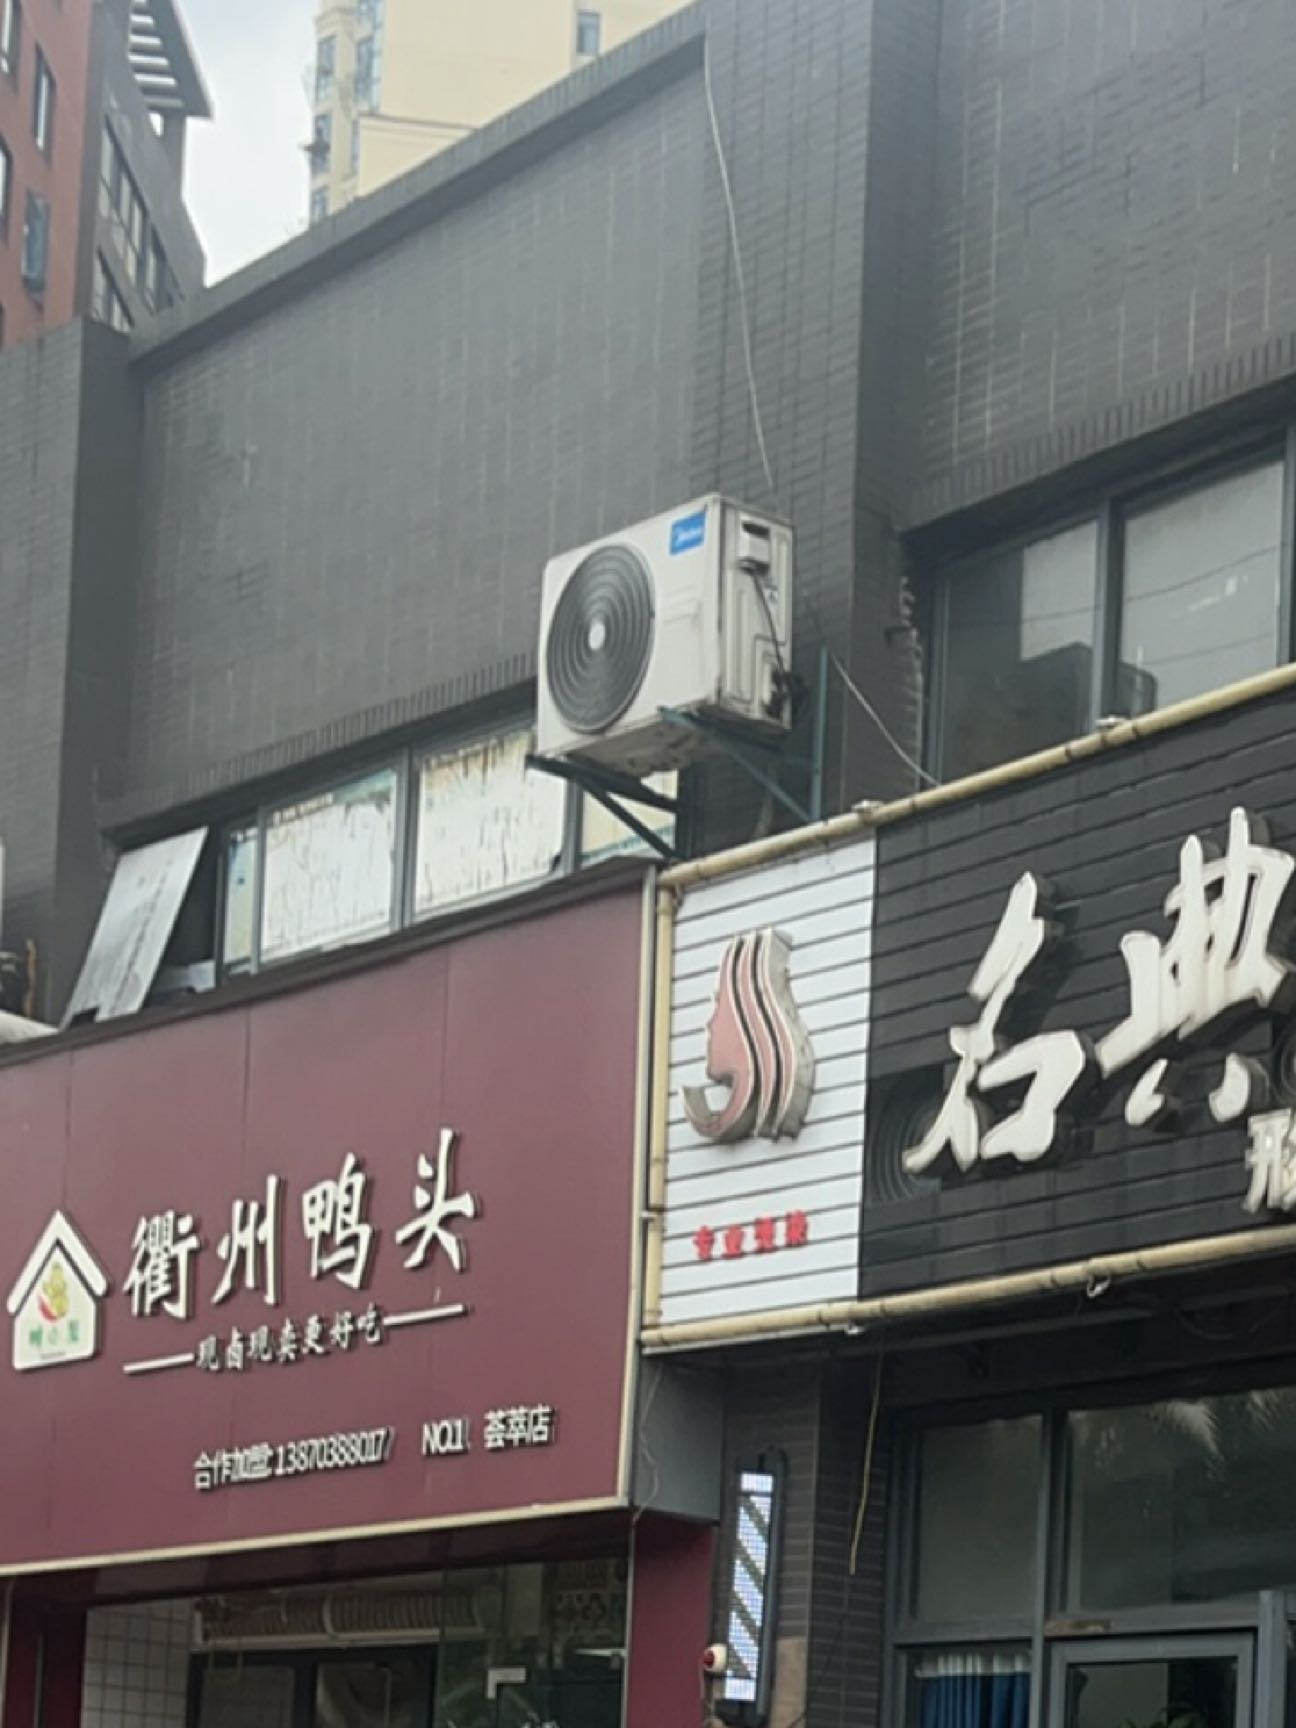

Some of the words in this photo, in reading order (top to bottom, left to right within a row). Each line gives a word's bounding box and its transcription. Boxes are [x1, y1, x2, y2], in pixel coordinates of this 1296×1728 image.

[122, 1127, 480, 1320] 衢州鸭头
[484, 1404, 556, 1450] 荟萃店
